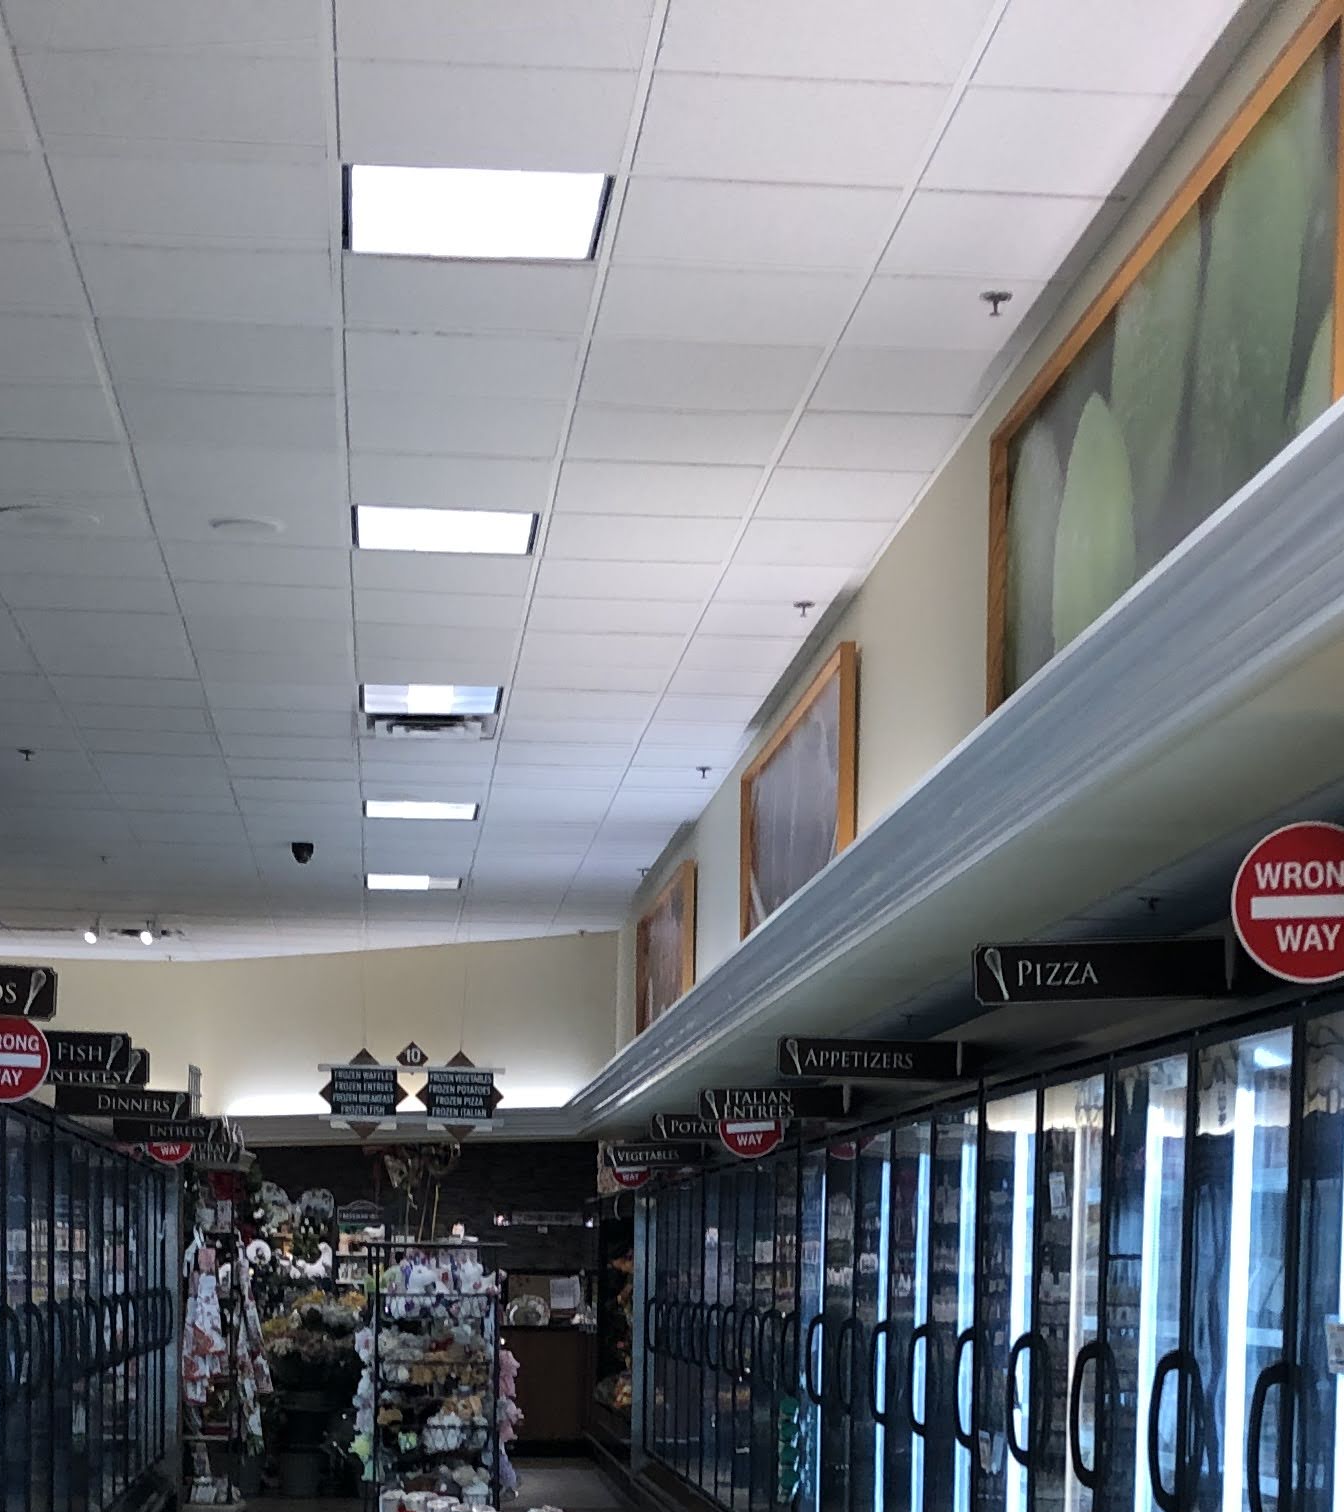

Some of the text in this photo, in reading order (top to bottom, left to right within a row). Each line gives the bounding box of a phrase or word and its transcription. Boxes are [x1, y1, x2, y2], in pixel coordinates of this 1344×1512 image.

[1275, 923, 1341, 952] WAY
[1017, 960, 1099, 988] PIZZA
[57, 1042, 102, 1063] FISH
[406, 1048, 421, 1062] 10
[805, 1048, 913, 1070] APPETIZERS
[98, 1094, 170, 1113] DINNERS
[726, 1089, 791, 1104] ITALIAN
[724, 1104, 795, 1119] ENTREES
[150, 1124, 205, 1137] ENTREES
[737, 1134, 763, 1147] WAY
[160, 1144, 181, 1156] WAY
[618, 1151, 680, 1162] VEGETABLES
[623, 1173, 640, 1181] WAY
